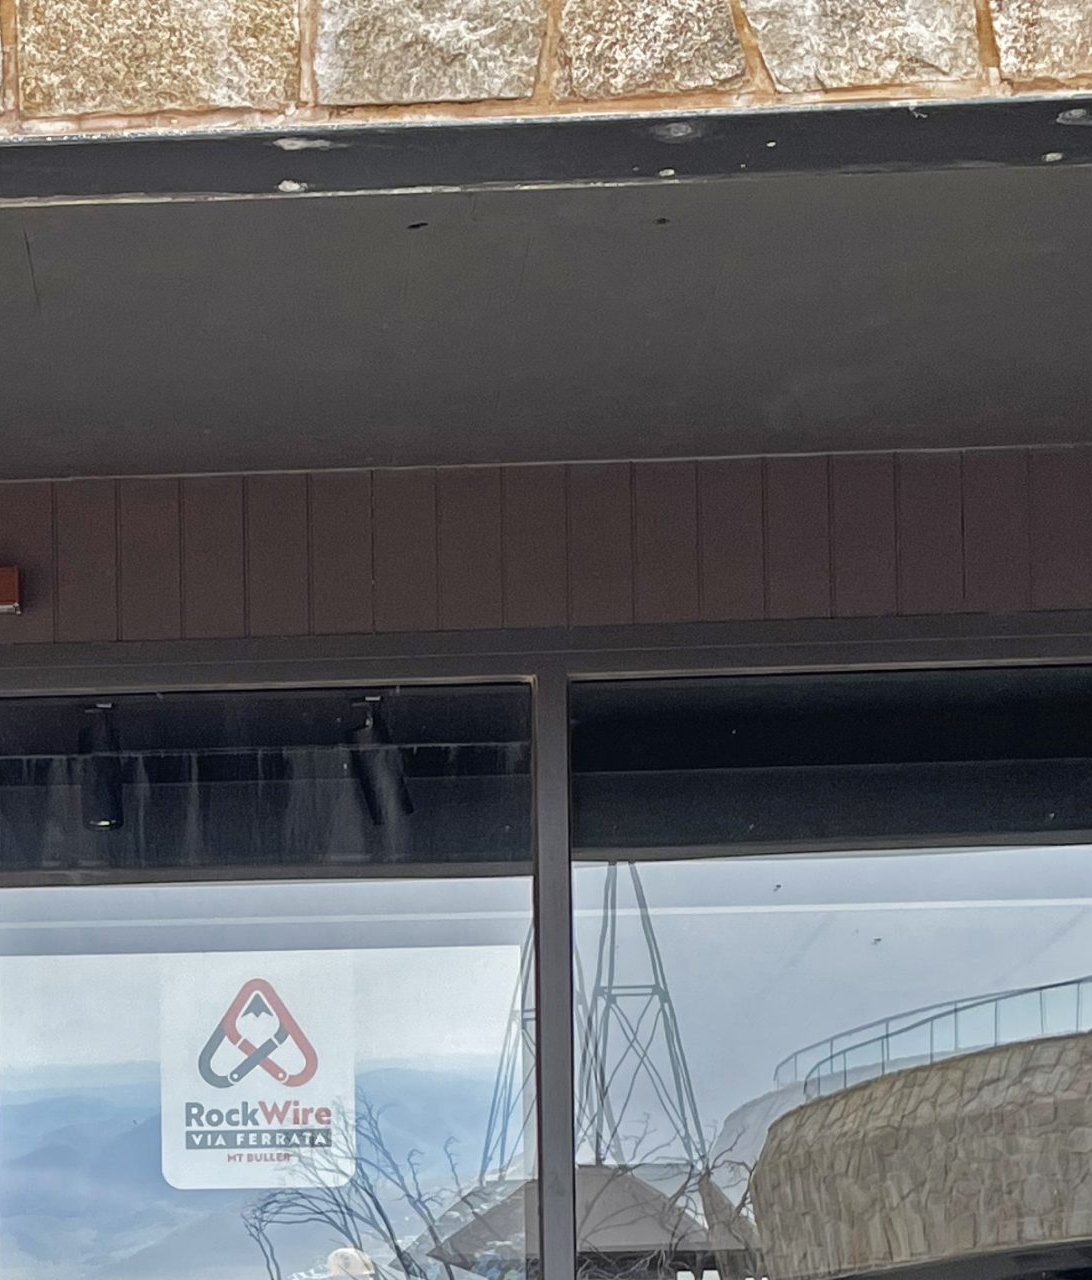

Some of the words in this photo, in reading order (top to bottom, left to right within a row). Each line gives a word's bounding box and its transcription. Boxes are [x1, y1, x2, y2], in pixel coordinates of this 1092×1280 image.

[185, 1100, 332, 1127] RockWire
[191, 1134, 226, 1146] VIA
[236, 1132, 327, 1146] FERRATA
[227, 1153, 243, 1163] MT
[246, 1152, 291, 1162] BULLER
